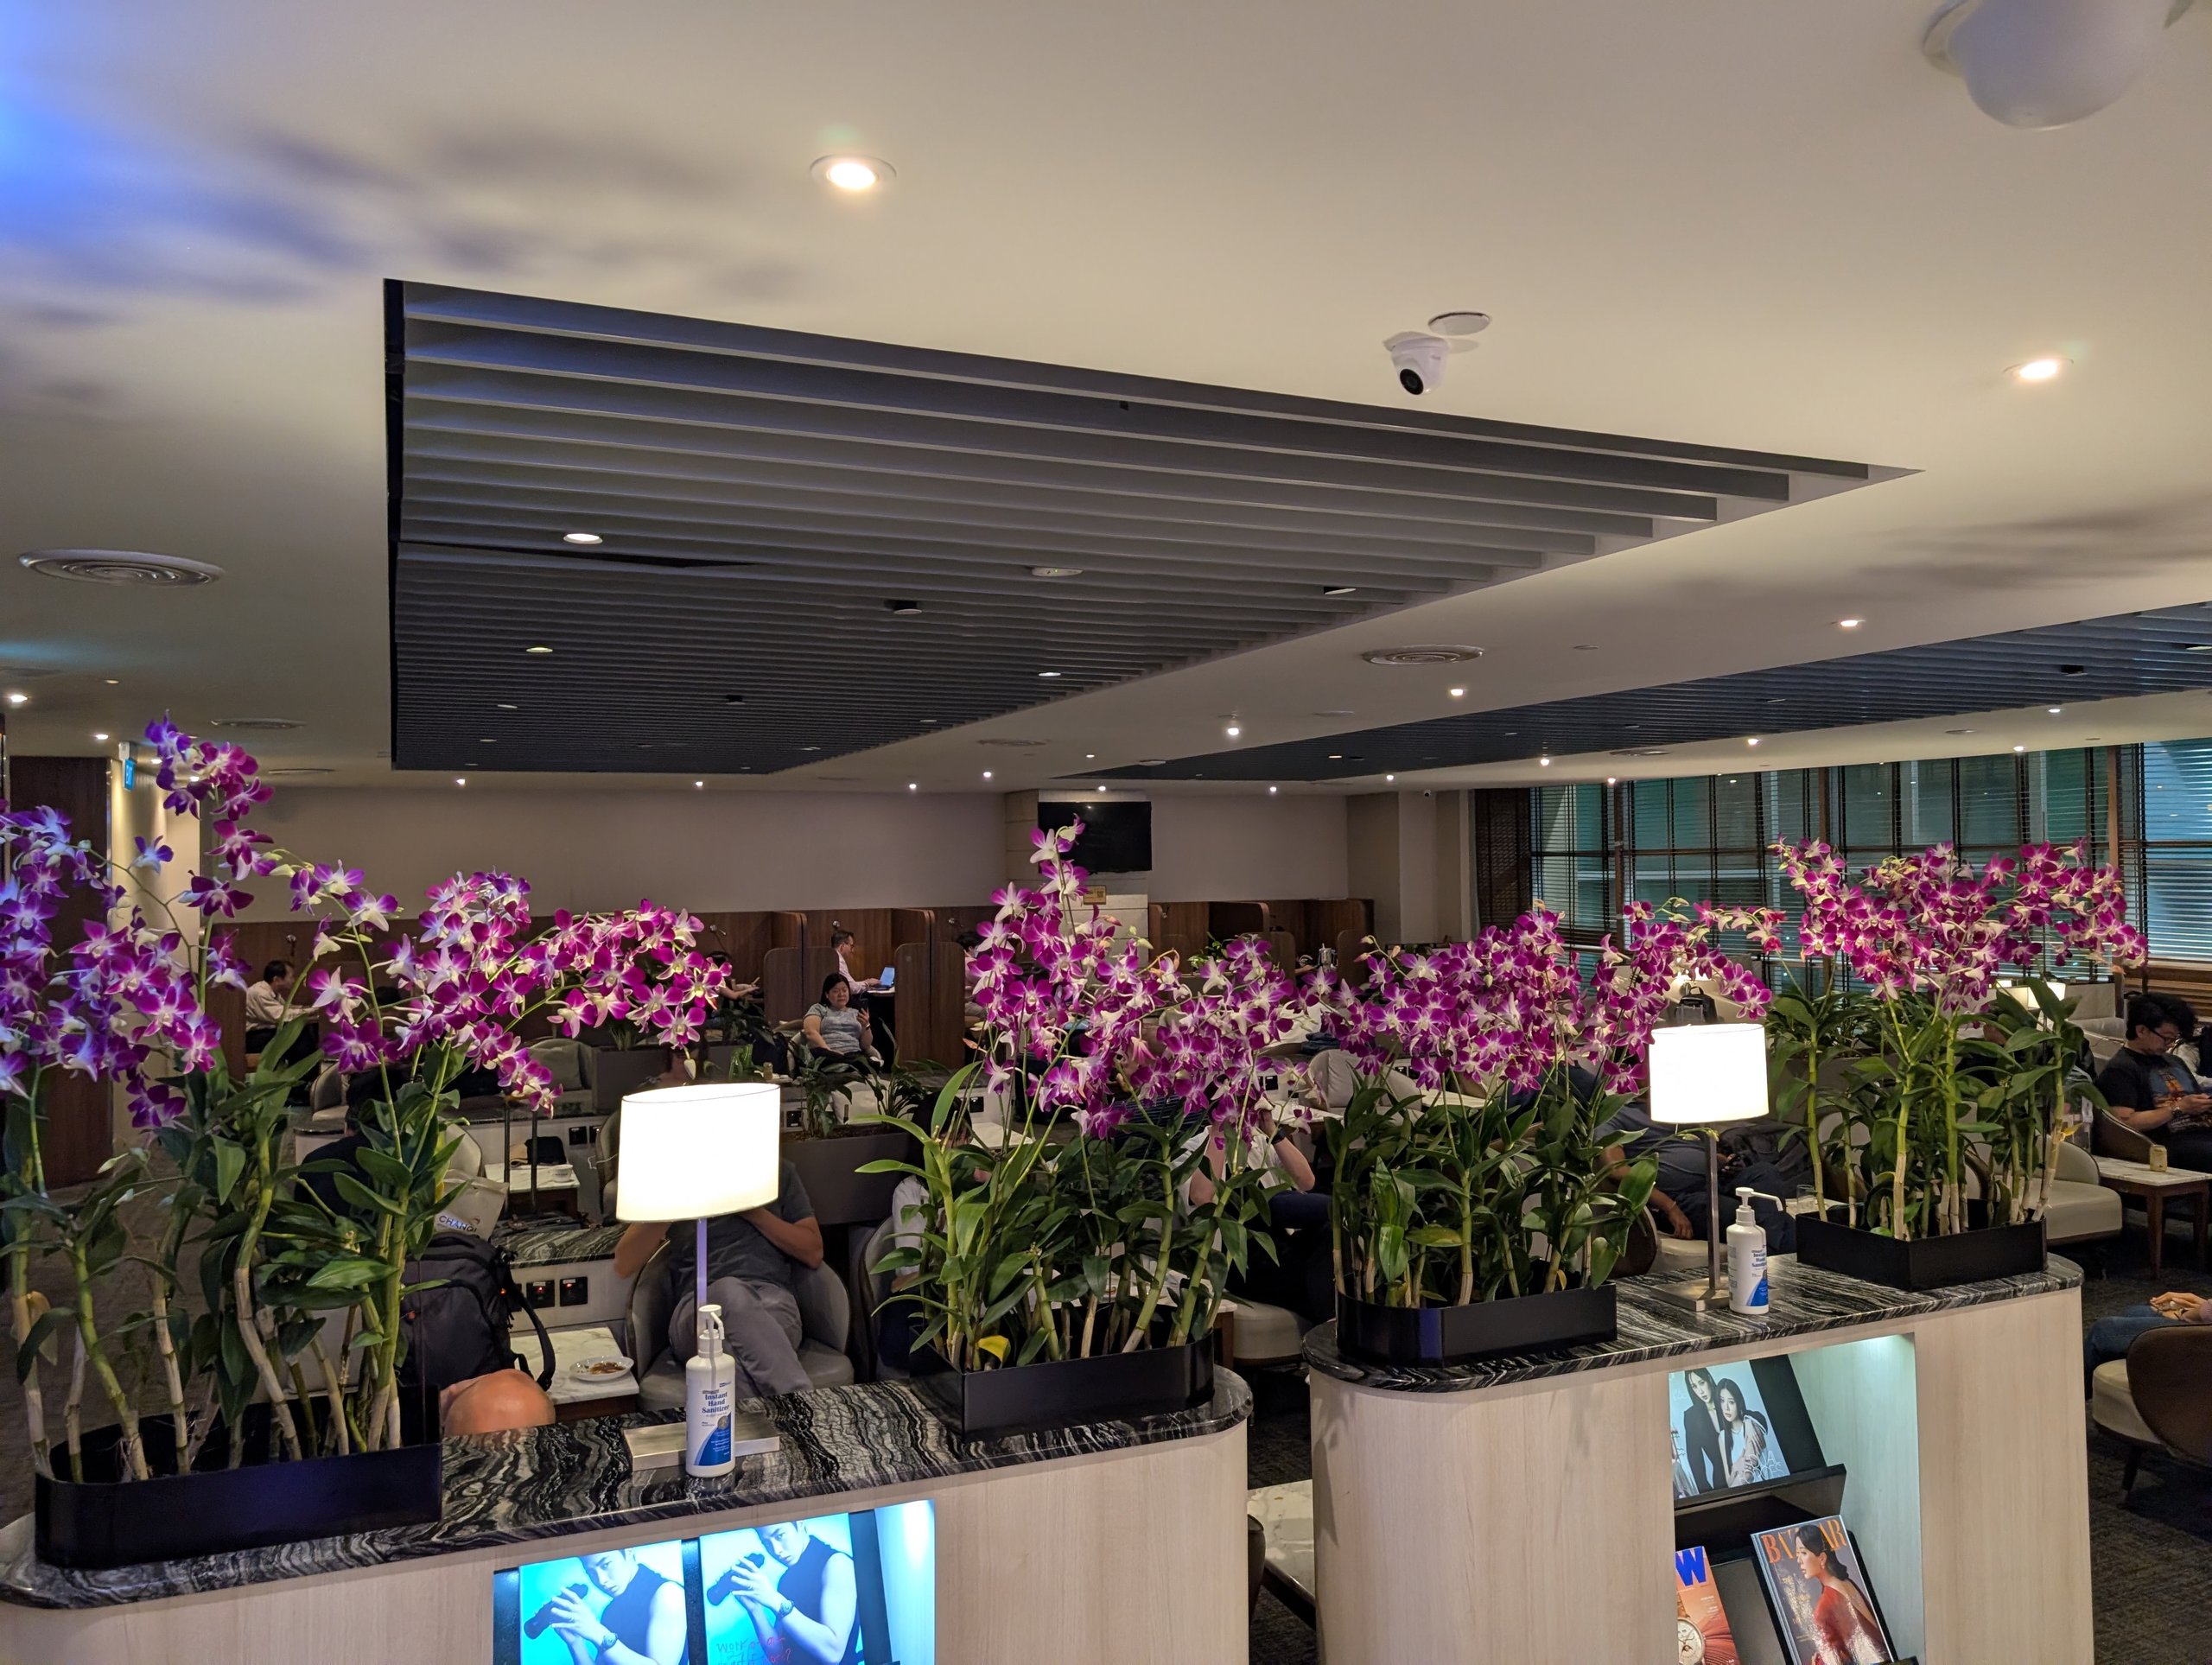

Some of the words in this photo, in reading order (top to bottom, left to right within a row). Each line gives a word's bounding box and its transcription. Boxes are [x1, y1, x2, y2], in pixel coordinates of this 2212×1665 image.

[705, 1391, 728, 1400] Instant
[709, 1398, 726, 1407] Hand
[702, 1404, 730, 1414] Sanitizer
[1761, 1519, 1847, 1563] BAAR
